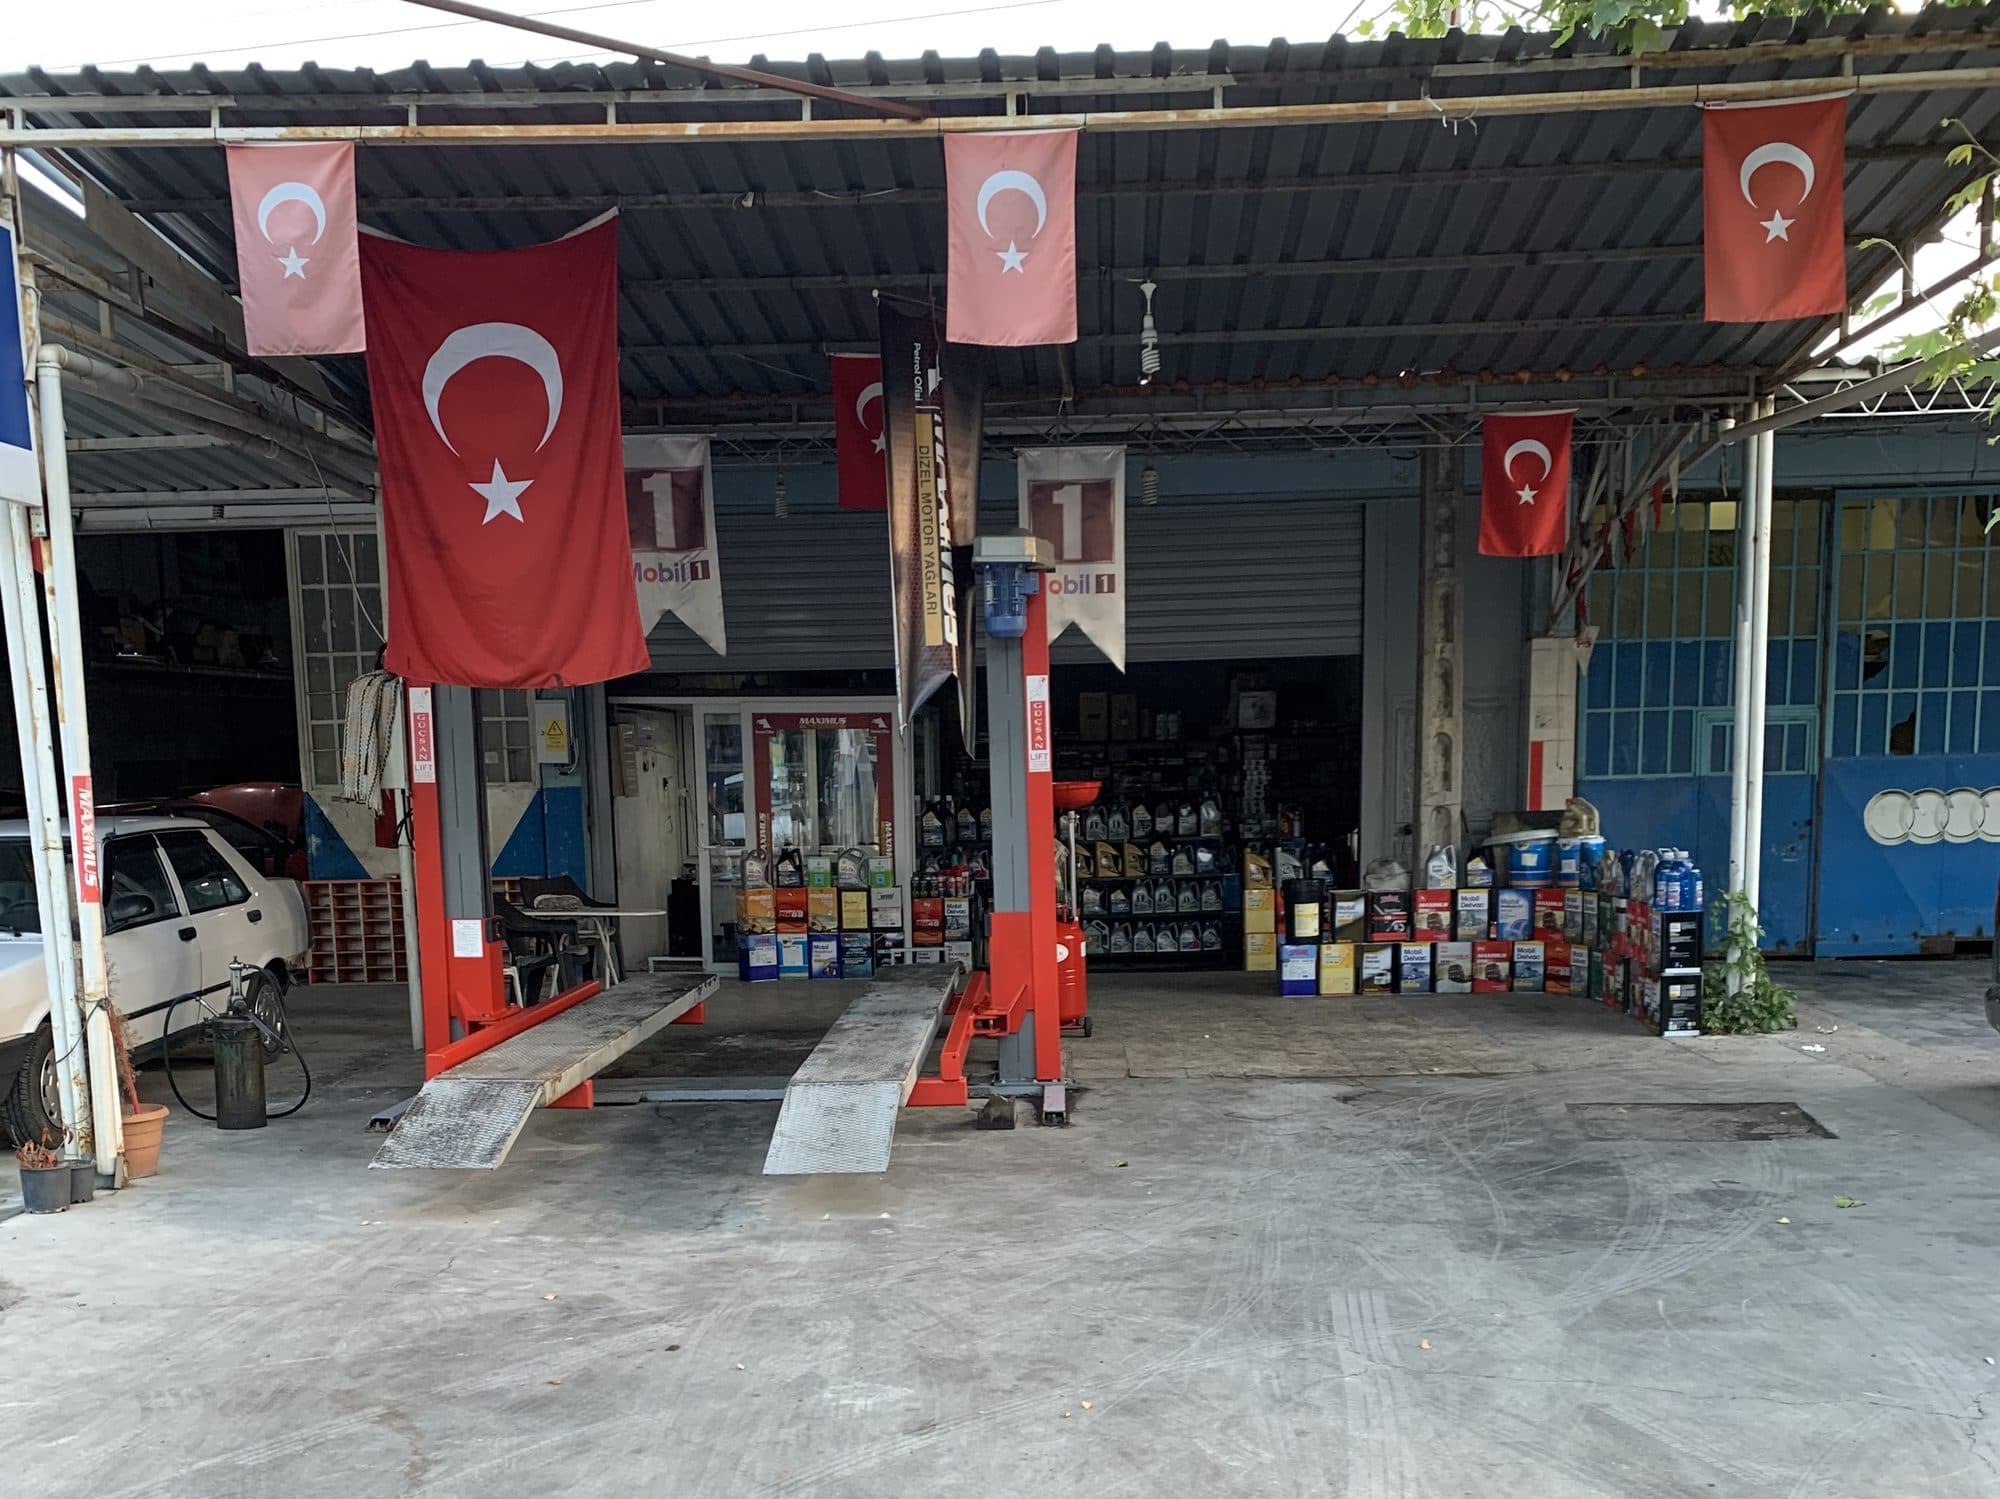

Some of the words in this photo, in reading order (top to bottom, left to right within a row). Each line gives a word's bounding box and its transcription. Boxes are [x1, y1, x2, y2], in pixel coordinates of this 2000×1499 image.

[913, 342, 922, 374] Petrol
[914, 376, 923, 401] Ofisi
[642, 472, 676, 549] 1
[921, 492, 936, 546] MOTOR
[1052, 484, 1082, 560] 1
[1048, 574, 1090, 594] obil
[799, 717, 847, 726] MAXIMUS
[1031, 752, 1048, 760] LIFT
[79, 788, 97, 886] MAXIMUS
[759, 812, 768, 851] AXIMUS
